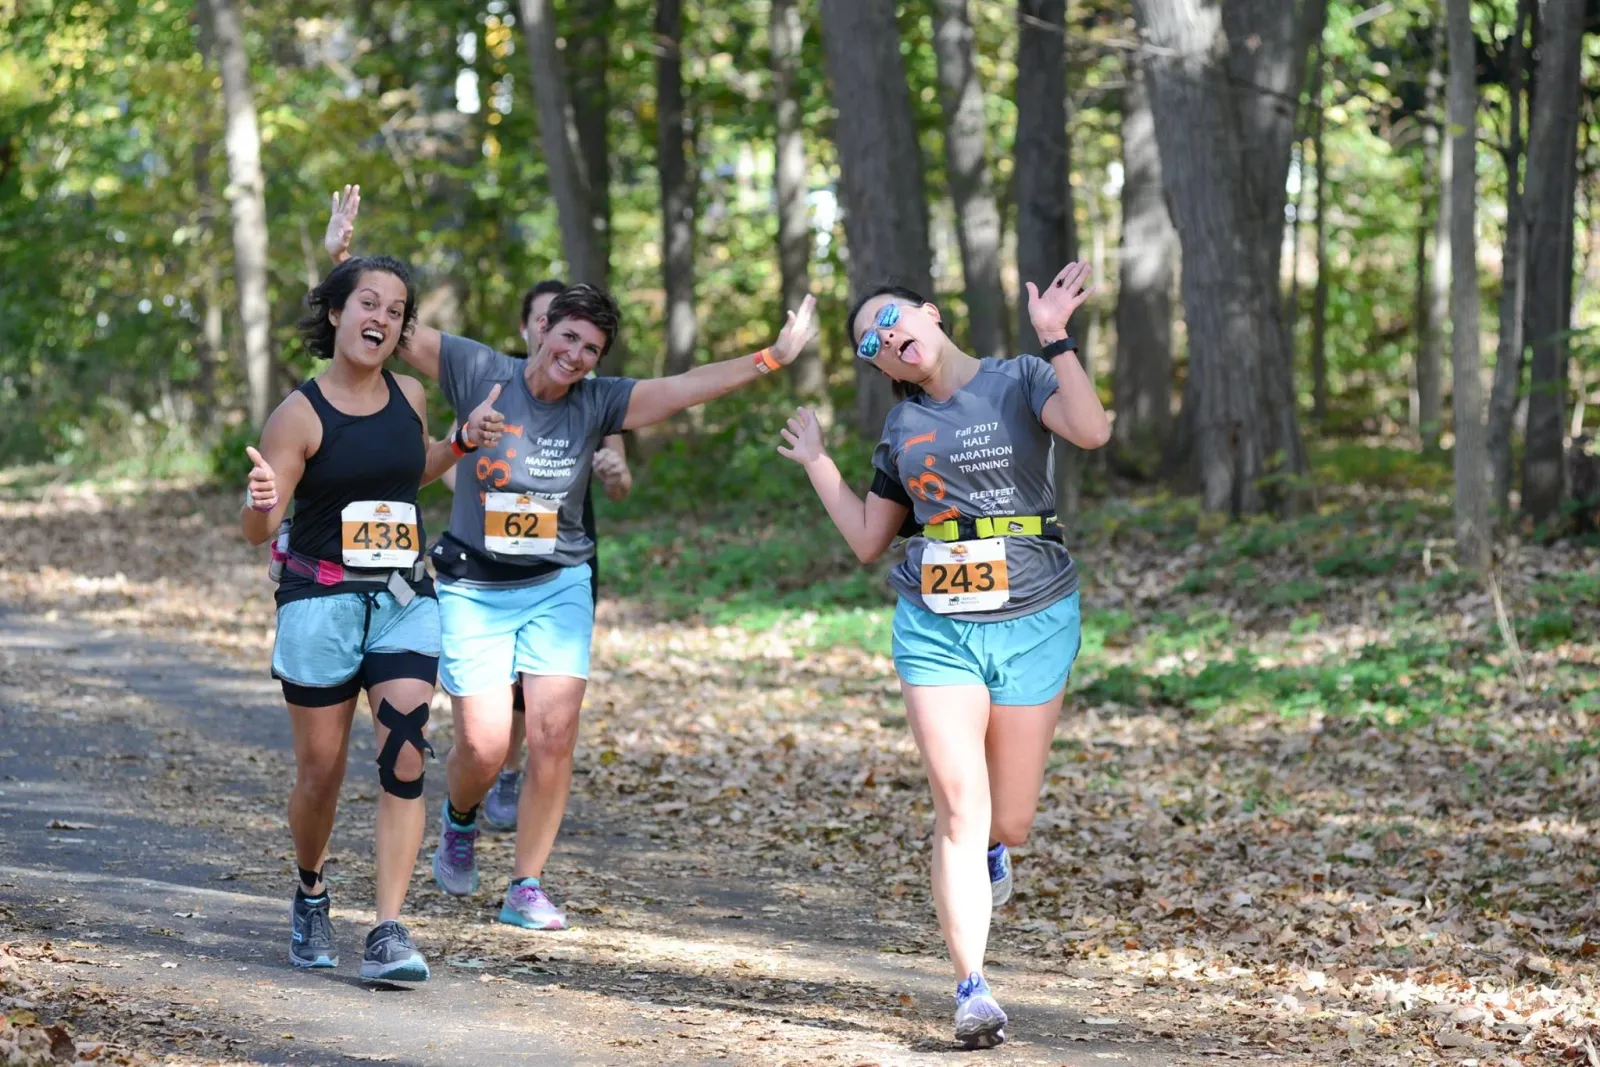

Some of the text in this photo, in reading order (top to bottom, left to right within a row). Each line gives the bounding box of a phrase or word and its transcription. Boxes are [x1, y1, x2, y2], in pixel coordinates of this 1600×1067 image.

[955, 421, 999, 438] Fall 2017
[536, 437, 552, 447] Fall
[962, 435, 991, 448] HALF
[540, 448, 565, 458] HALF
[949, 445, 1013, 464] MARATHON
[524, 456, 577, 468] MARATHON
[958, 458, 1009, 474] TRAINING
[528, 467, 571, 478] TRAINING
[504, 513, 539, 538] 62
[353, 522, 412, 550] 438
[931, 562, 995, 594] 243
